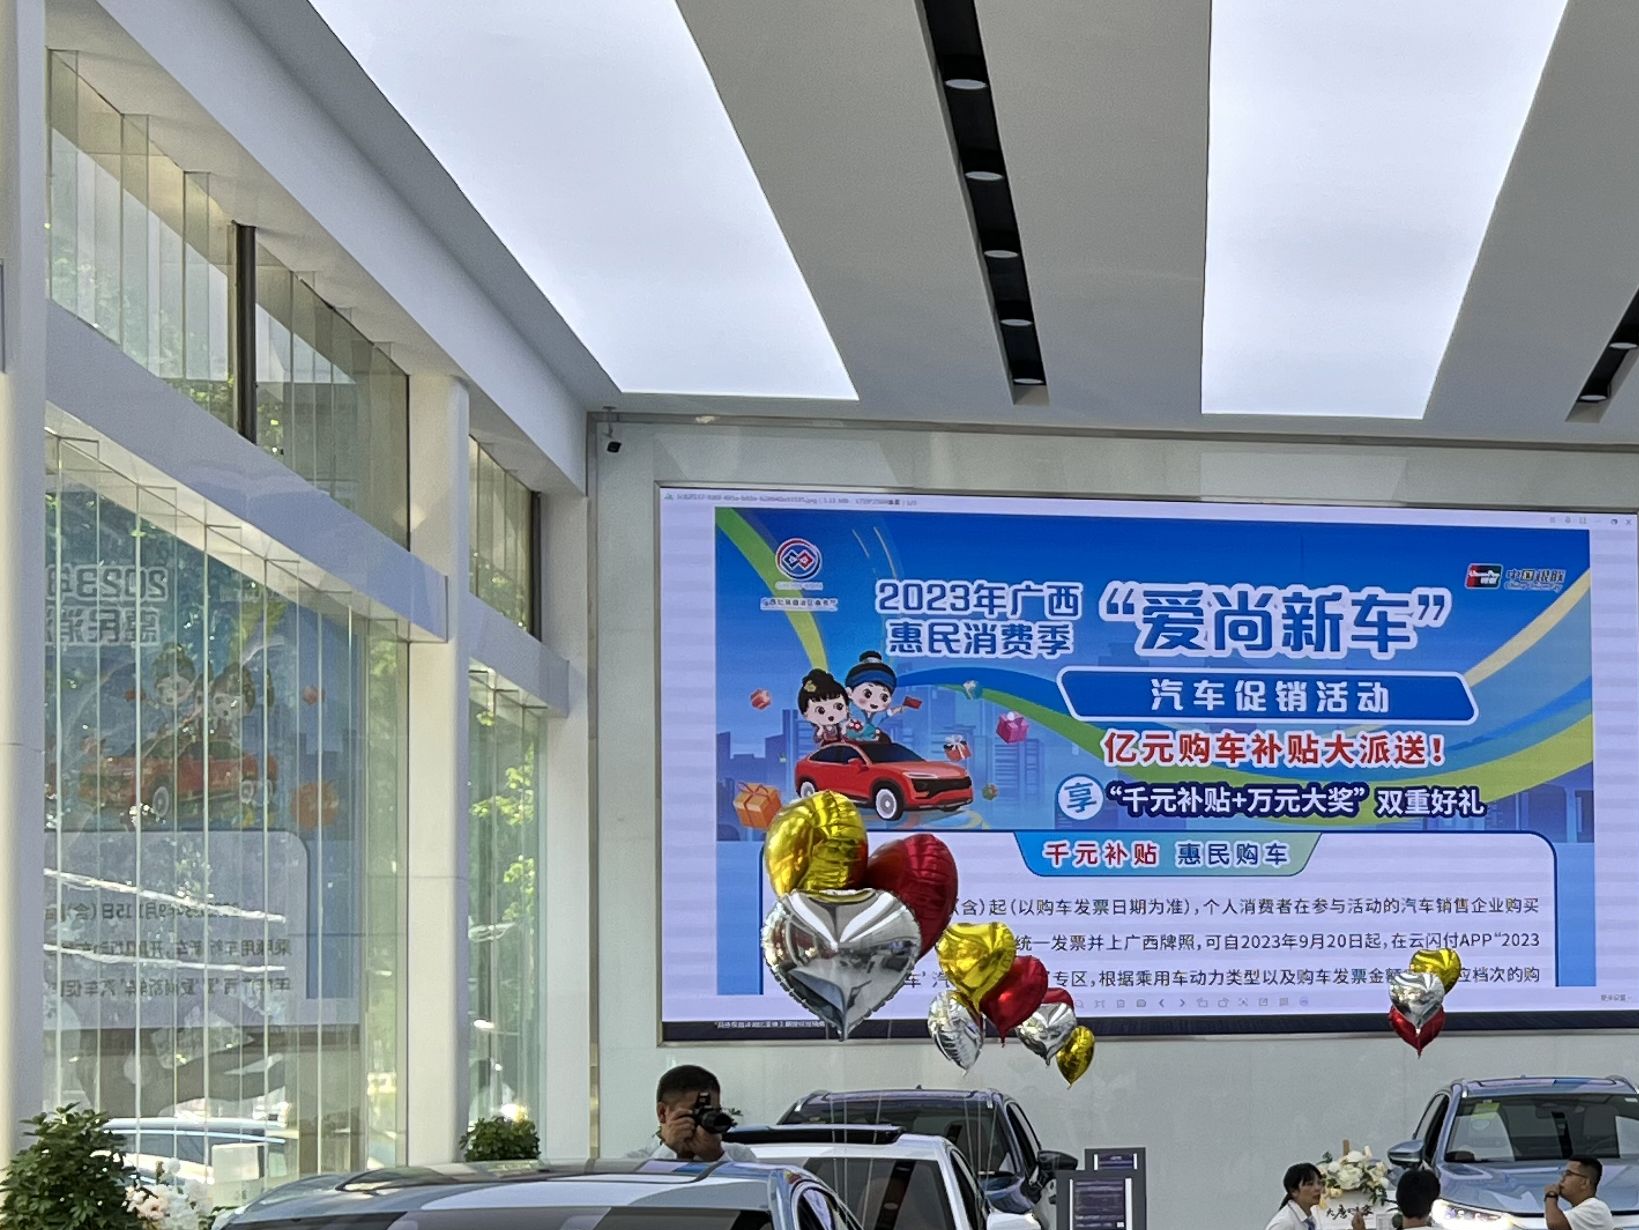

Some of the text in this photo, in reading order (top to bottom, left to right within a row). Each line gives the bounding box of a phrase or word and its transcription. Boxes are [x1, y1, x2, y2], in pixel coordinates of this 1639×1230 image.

[877, 581, 1081, 618] 2023年广西
[888, 620, 1073, 656] 惠民消费季
[1150, 677, 1391, 713] 汽车促销活动
[1103, 731, 1447, 767] 亿元购车补贴大派送！
[1063, 781, 1099, 814] 享
[1376, 786, 1487, 818] 双重好礼
[1043, 840, 1290, 868] 千元补贴 惠民购车
